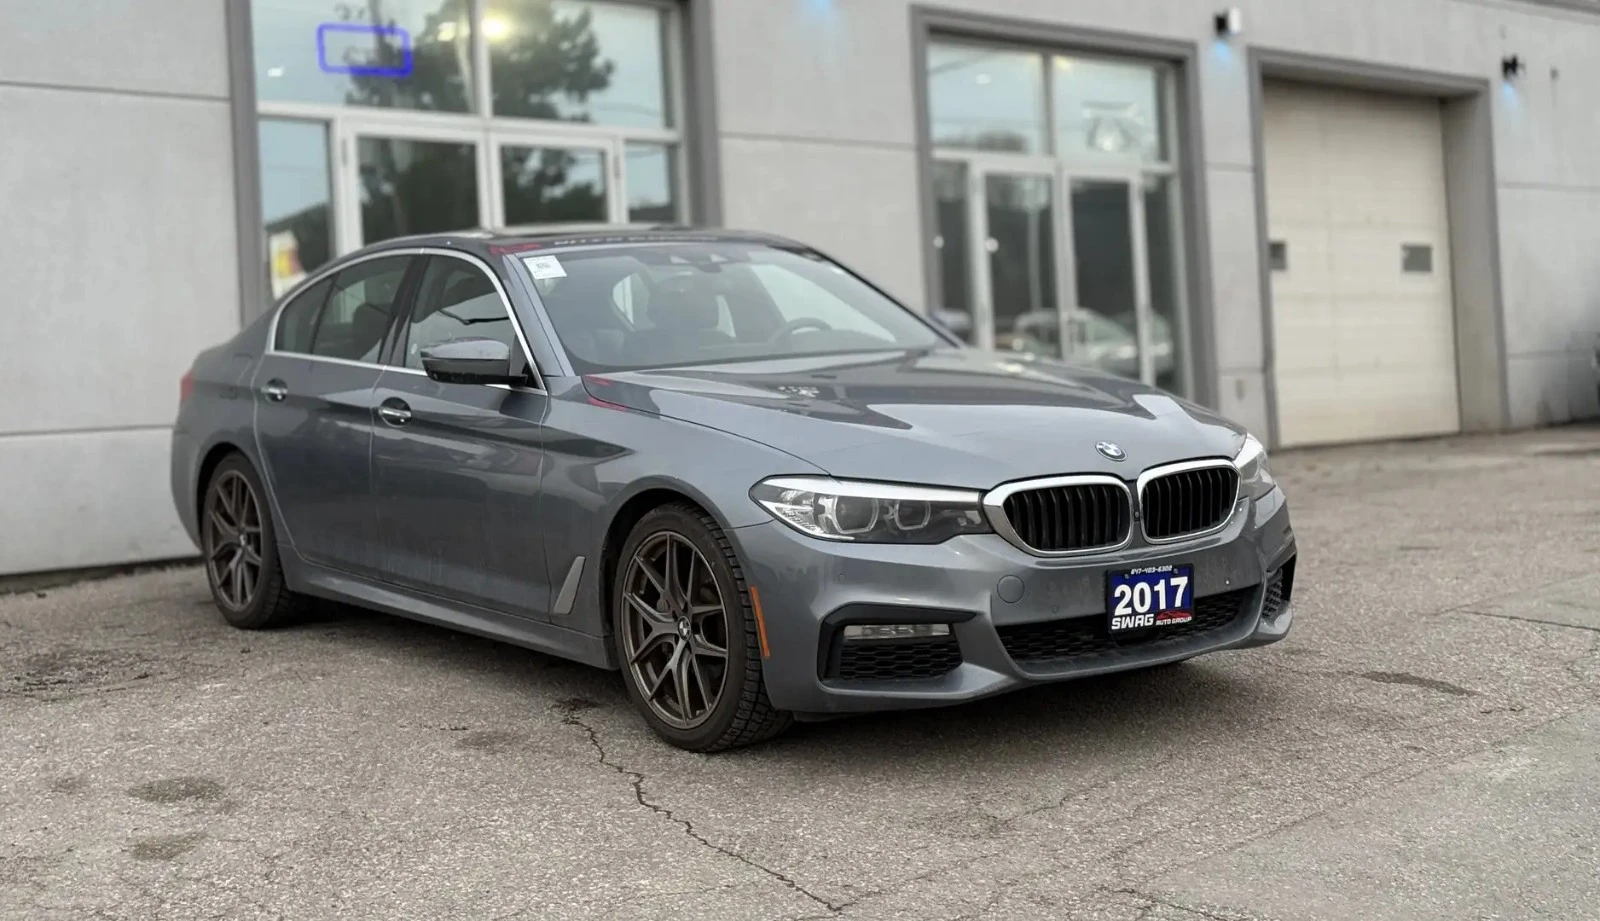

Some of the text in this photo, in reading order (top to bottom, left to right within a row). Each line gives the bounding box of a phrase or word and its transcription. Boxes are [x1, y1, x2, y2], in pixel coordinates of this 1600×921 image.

[1114, 576, 1188, 616] 2017
[1111, 613, 1192, 630] SWAG AUTO GROUP
